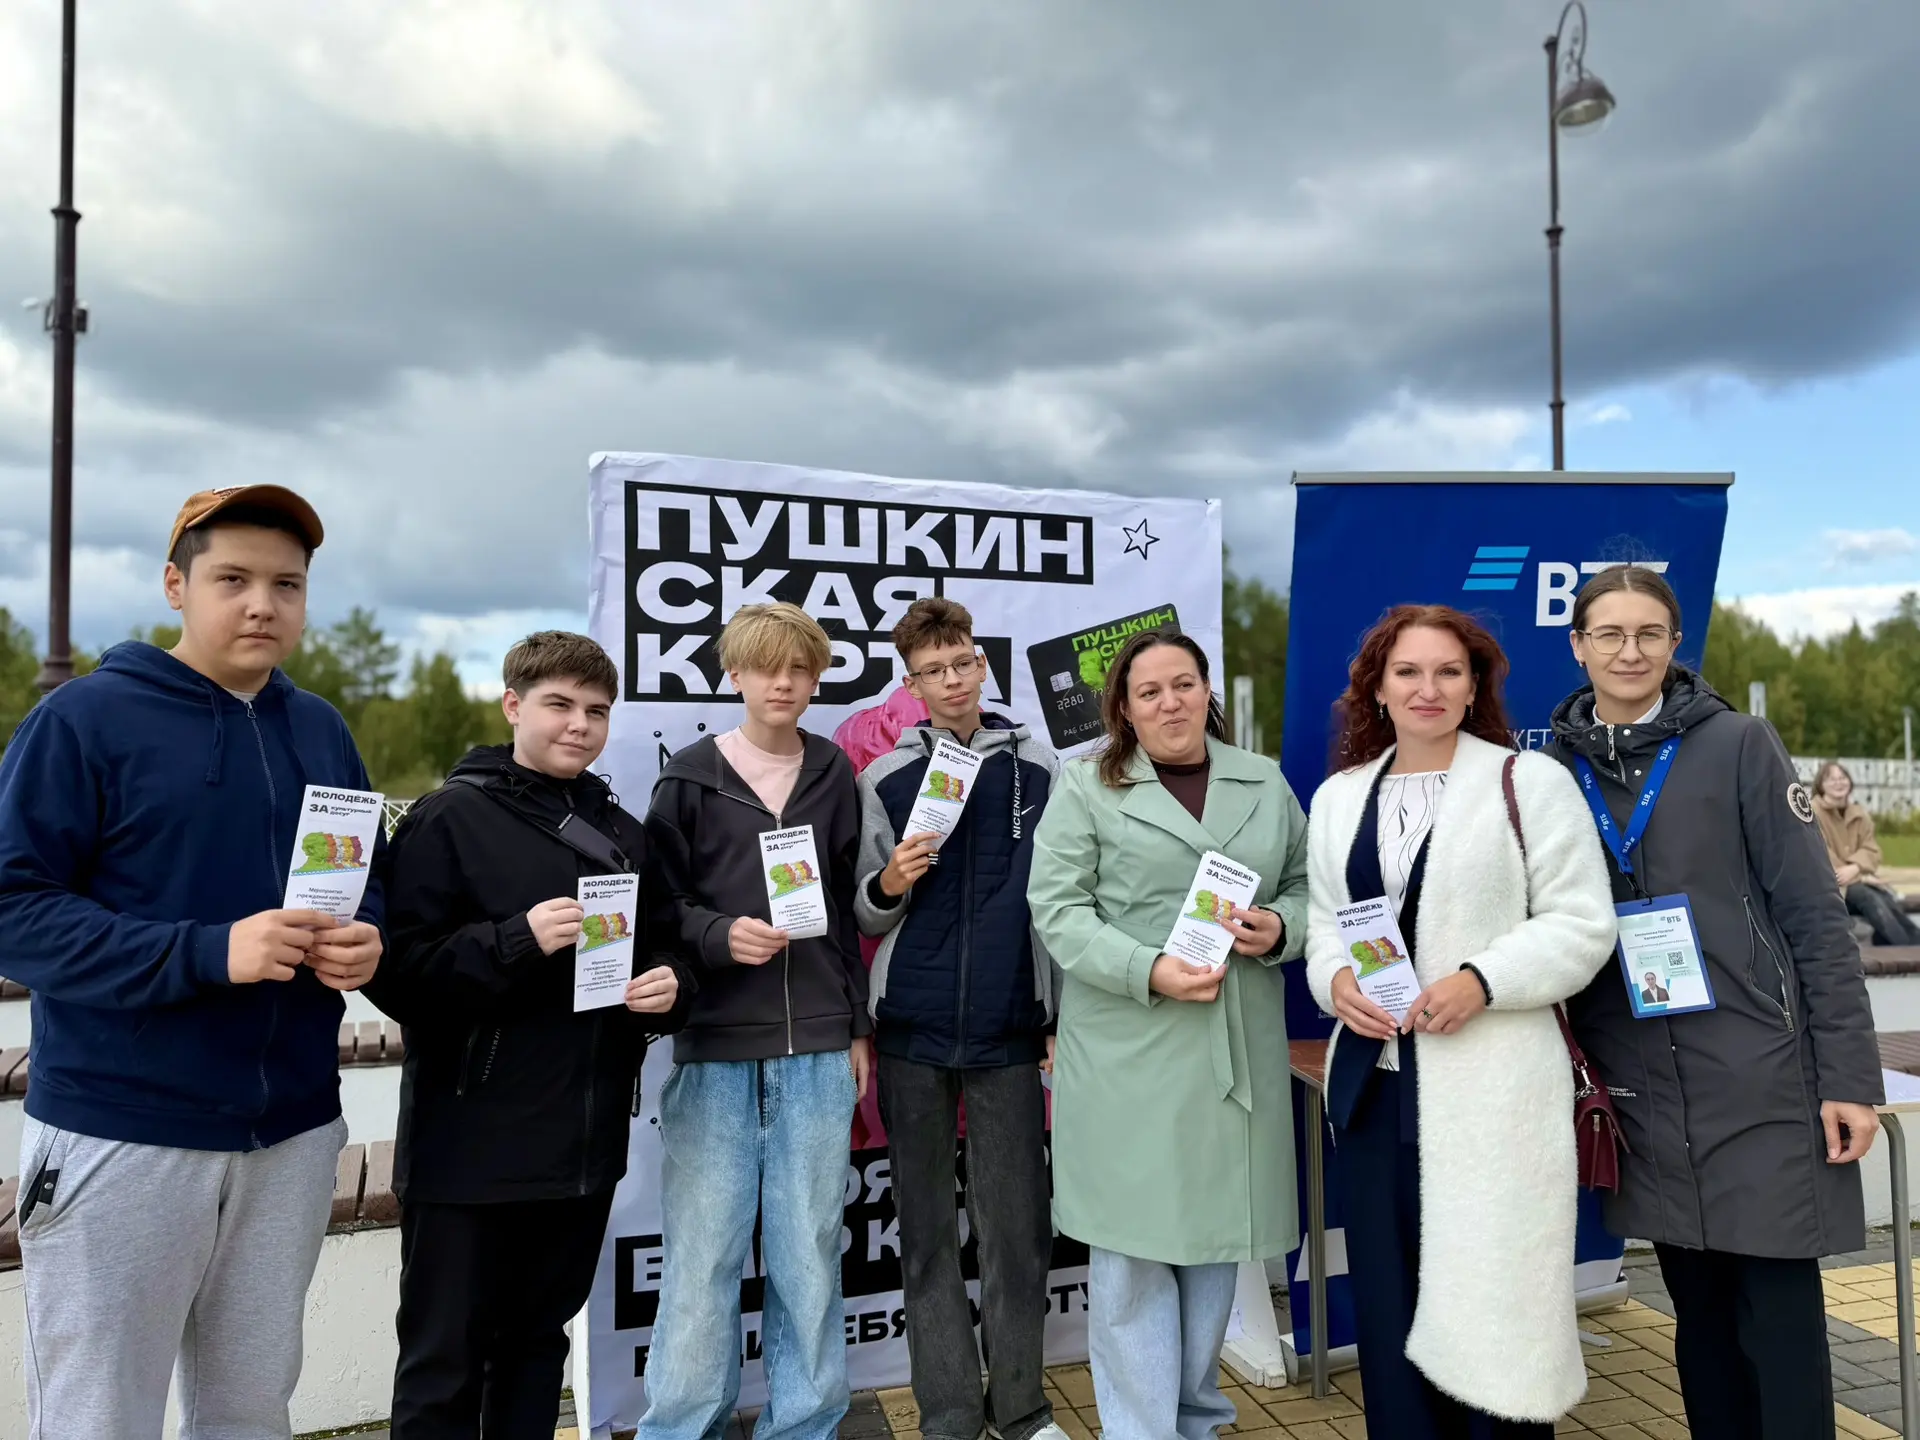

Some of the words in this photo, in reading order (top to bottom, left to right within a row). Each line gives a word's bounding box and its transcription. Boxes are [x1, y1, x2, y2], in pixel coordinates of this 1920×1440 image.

[637, 490, 1084, 574] ПУШКИН
[1072, 609, 1174, 651] ПУШКИН
[1057, 694, 1084, 710] 2280
[938, 750, 950, 760] ЗА
[309, 804, 328, 813] ЗА
[766, 844, 780, 852] ЗА
[1206, 868, 1219, 879] ЗА
[1341, 920, 1355, 928] ЗА
[1667, 915, 1681, 924] ВТБ
